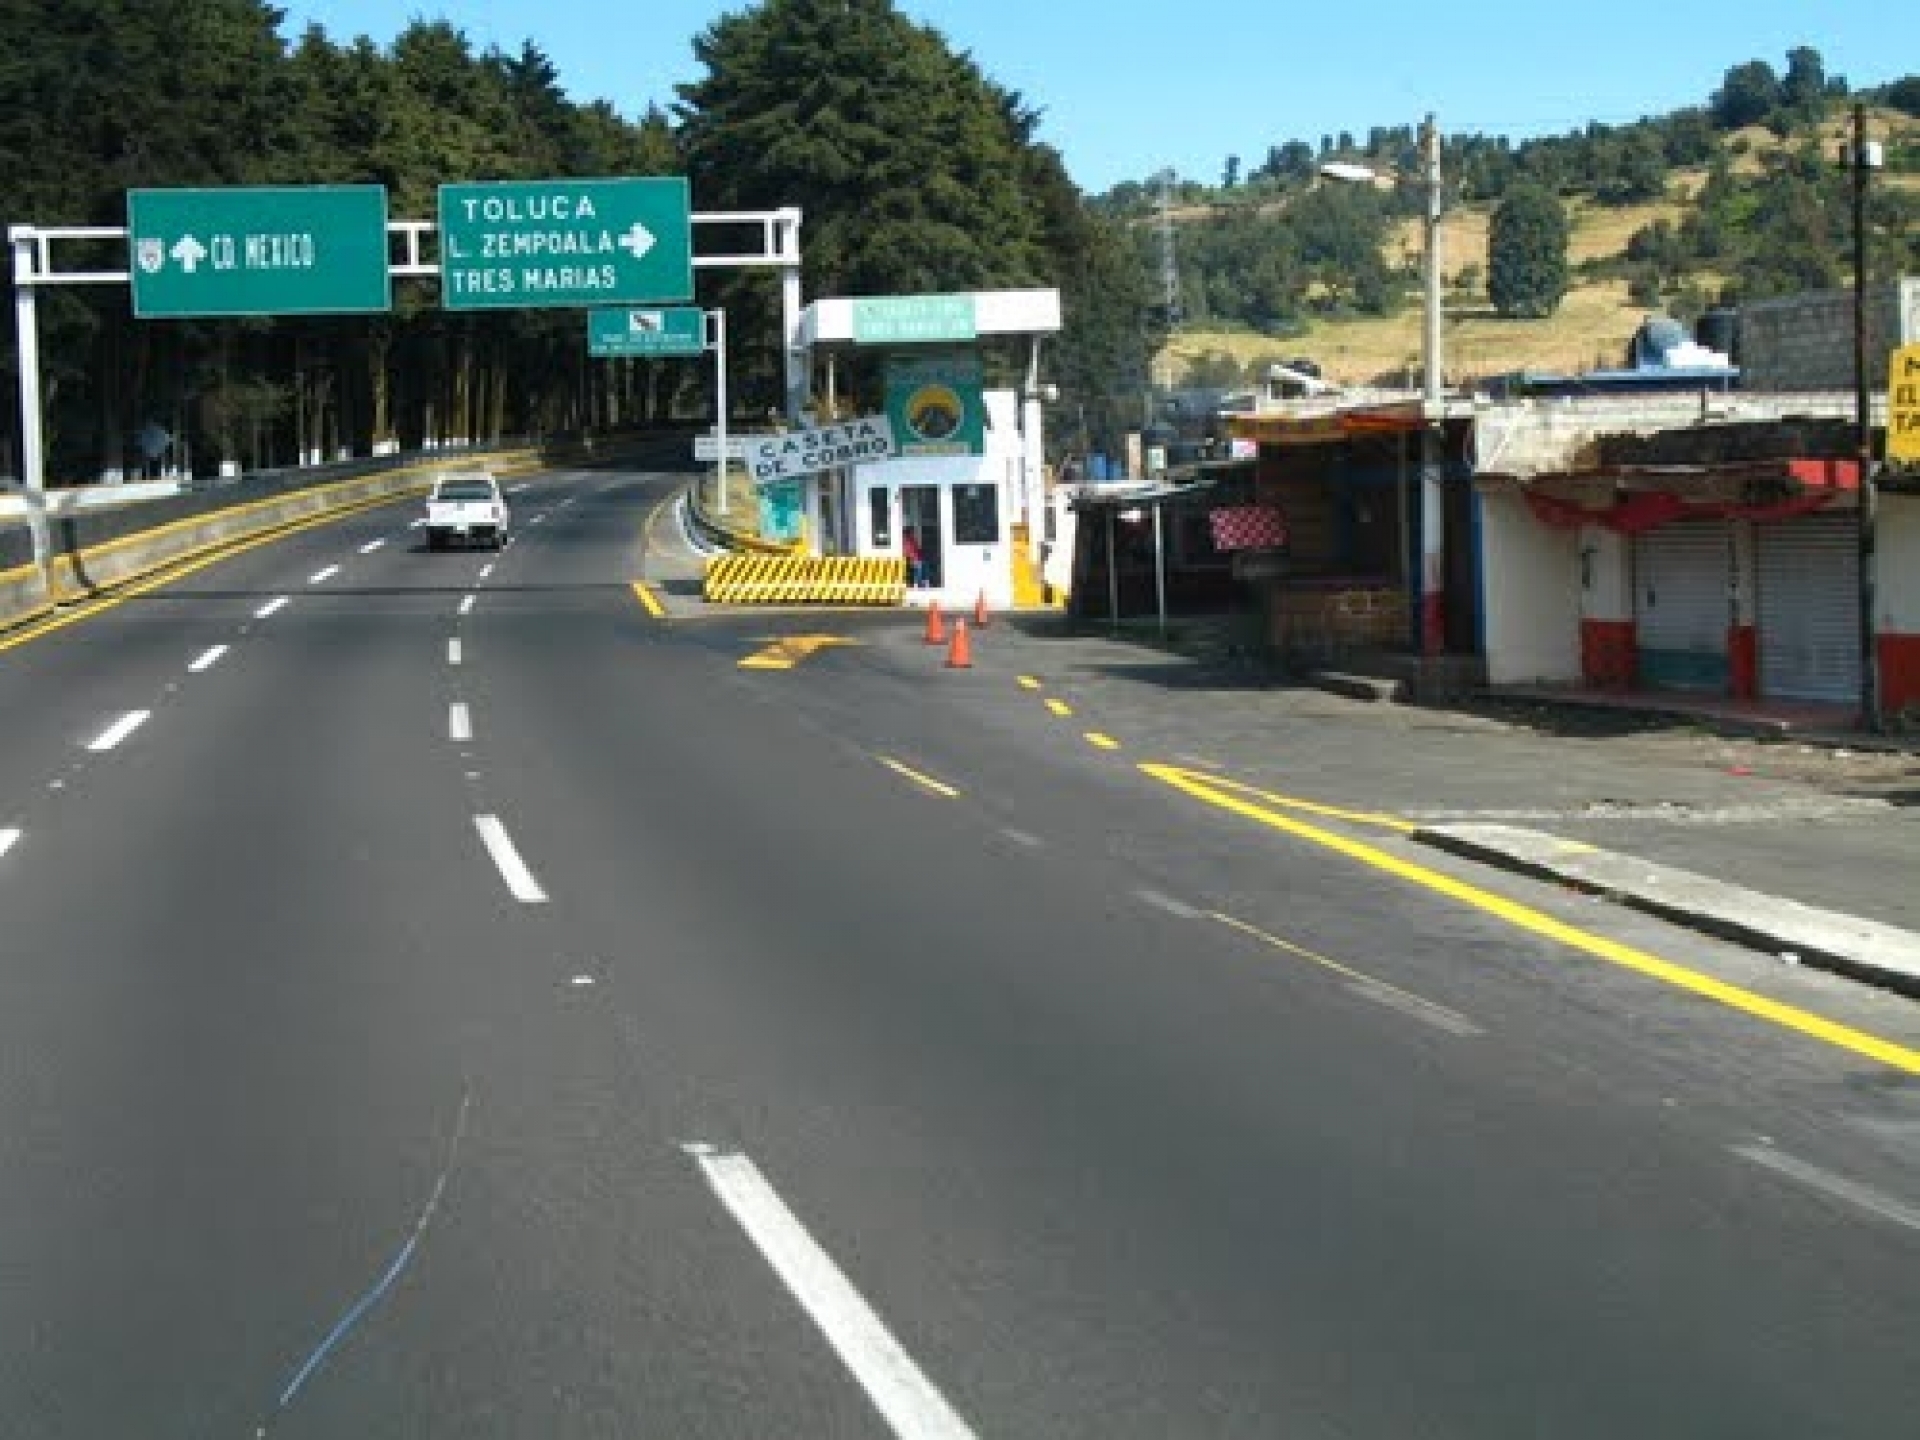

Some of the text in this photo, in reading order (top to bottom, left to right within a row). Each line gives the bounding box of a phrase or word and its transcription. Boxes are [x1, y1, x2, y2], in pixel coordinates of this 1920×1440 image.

[461, 195, 596, 223] TOLUCA
[245, 233, 316, 270] MEXICO
[480, 229, 615, 258] ZEMPOALA
[453, 264, 618, 293] TRES MARIAS
[760, 422, 876, 457] CASETA
